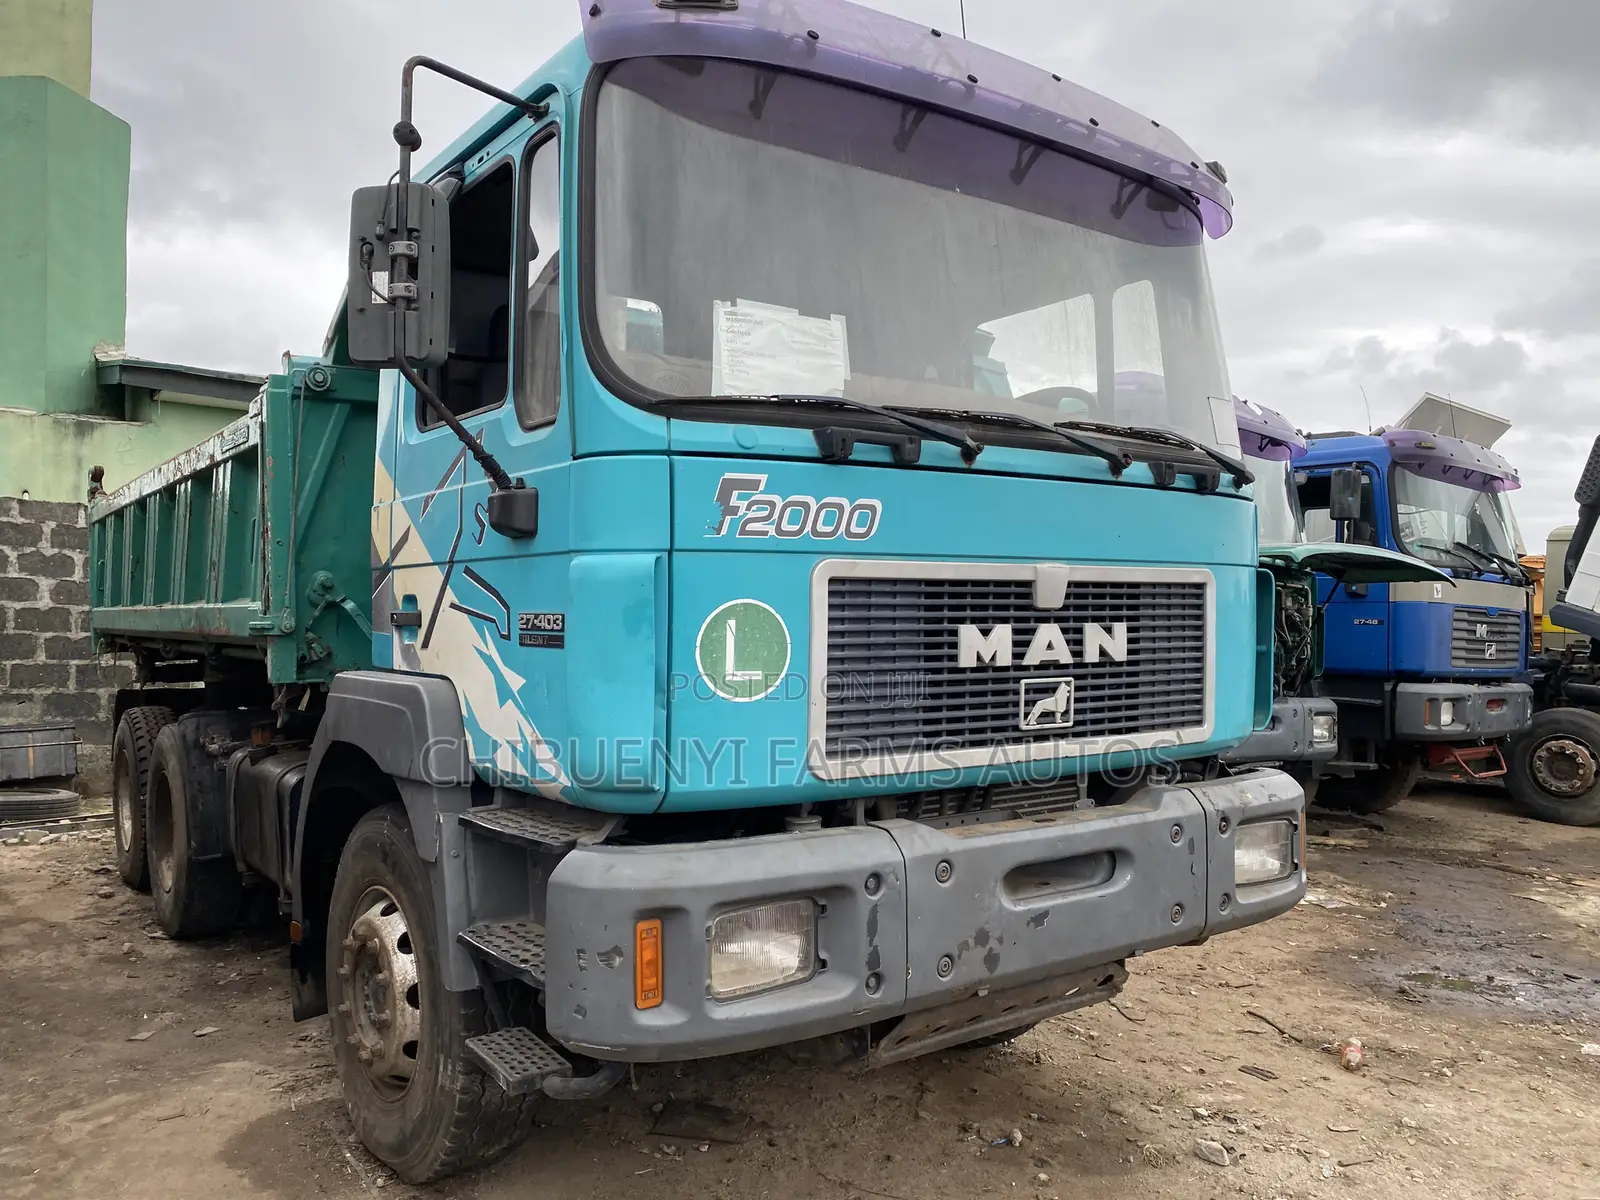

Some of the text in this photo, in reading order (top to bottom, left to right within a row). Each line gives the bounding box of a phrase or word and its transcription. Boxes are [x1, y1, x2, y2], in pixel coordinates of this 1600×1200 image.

[703, 473, 882, 541] F2000
[519, 634, 549, 645] SILENT
[725, 619, 763, 681] L
[957, 622, 1127, 668] MAN
